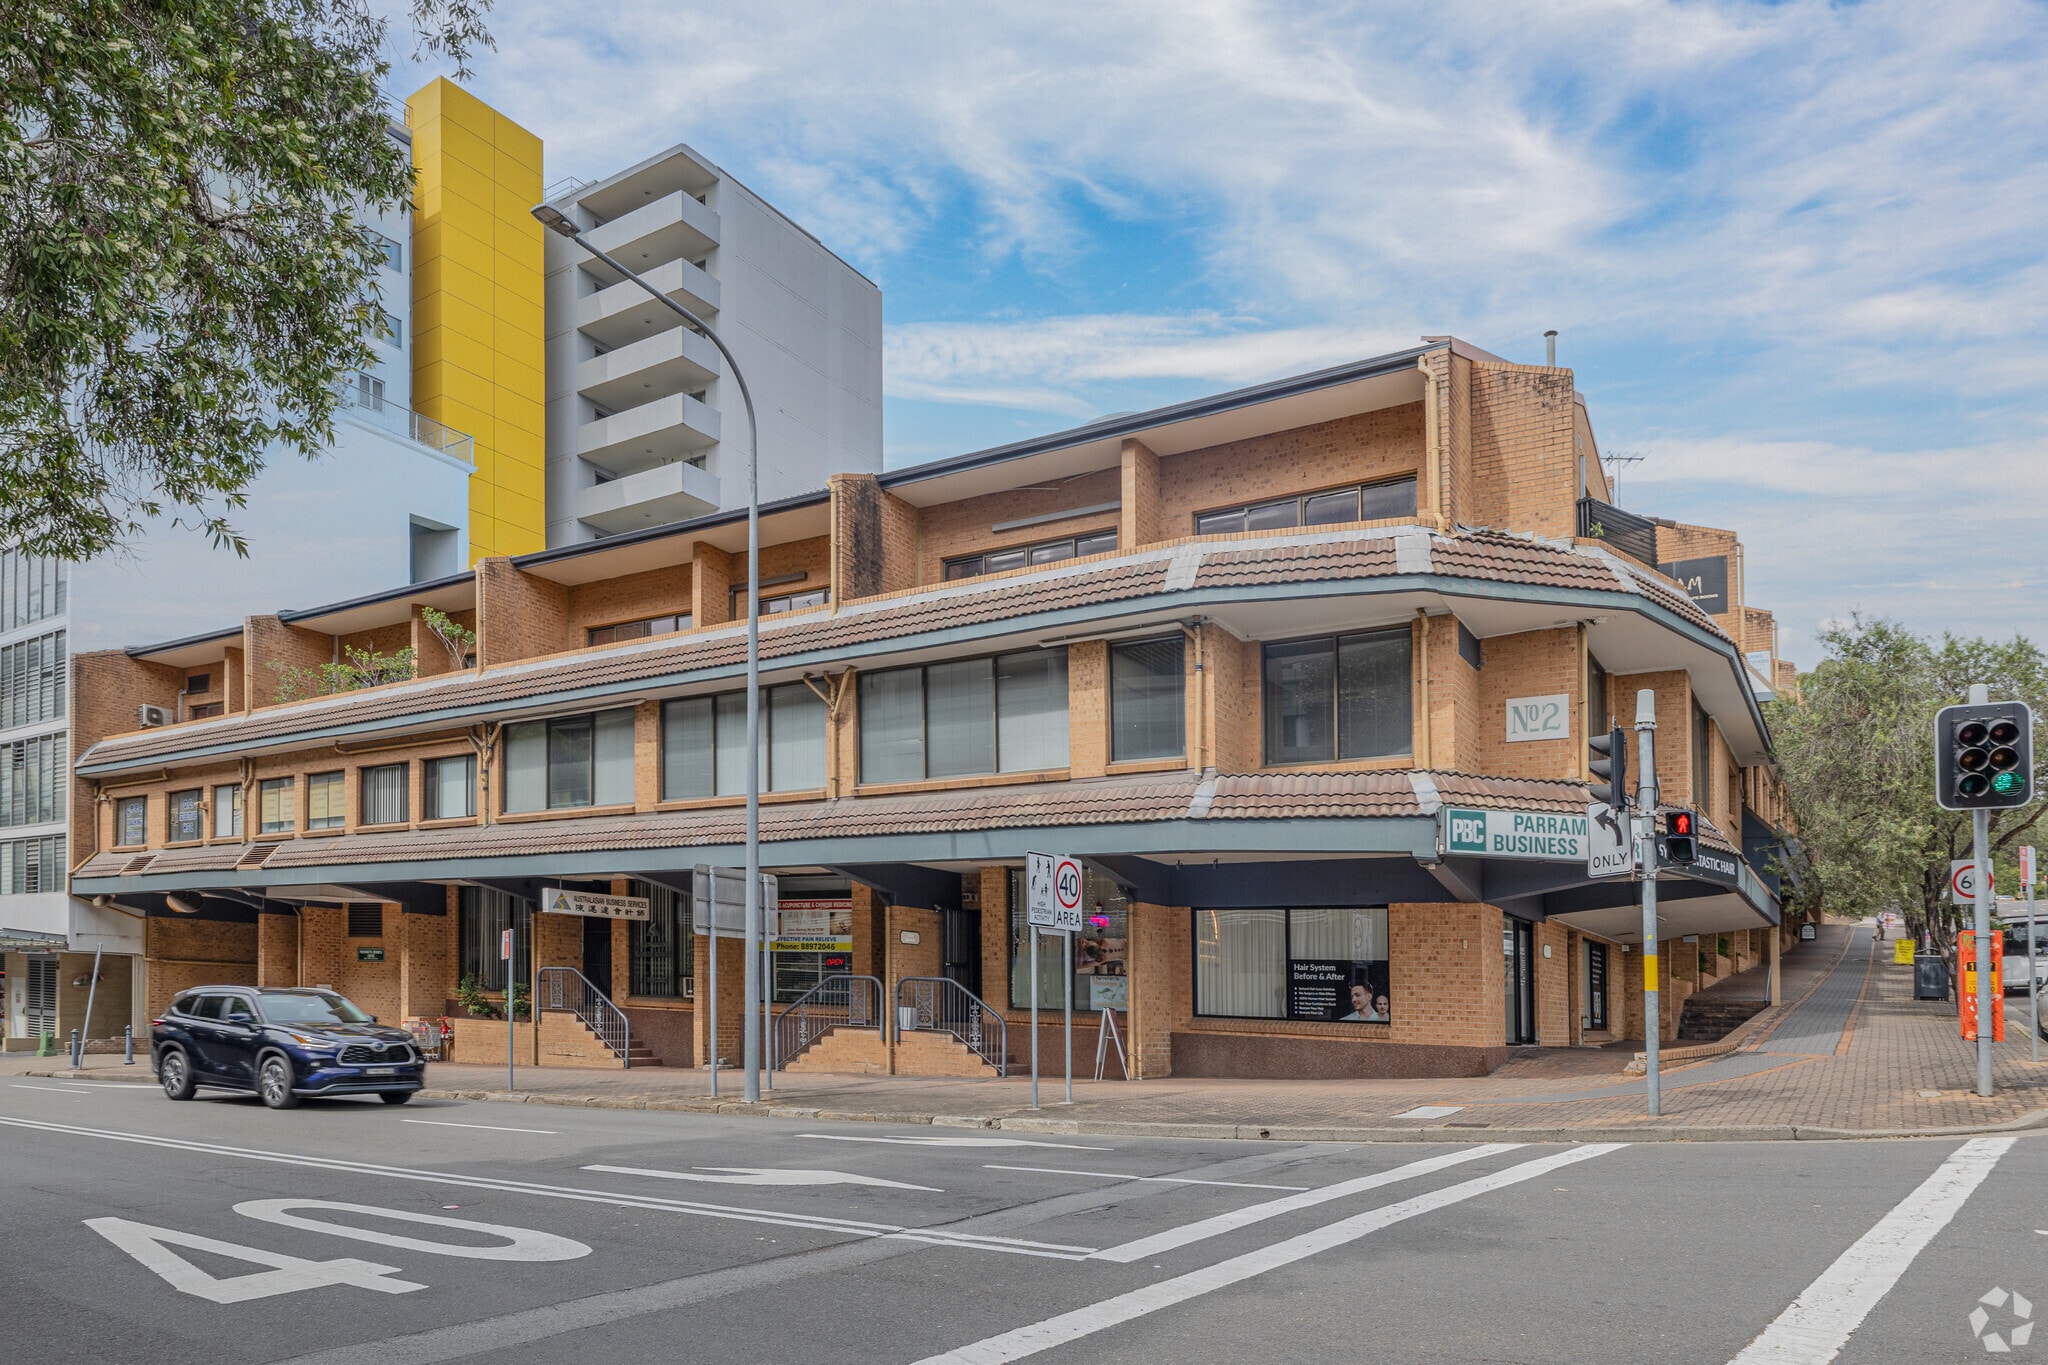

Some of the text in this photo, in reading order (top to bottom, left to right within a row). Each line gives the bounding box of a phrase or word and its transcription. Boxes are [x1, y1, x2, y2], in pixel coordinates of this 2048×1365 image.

[1452, 819, 1484, 844] PBC
[1514, 815, 1587, 836] PARRAM
[1494, 834, 1578, 856] BUSINESS
[1593, 852, 1628, 869] ONLY
[1720, 860, 1736, 876] HAIR
[1059, 873, 1078, 898] 40
[574, 895, 647, 909] AUSTRALASIAN BUSINESS SERVICES
[1031, 907, 1052, 915] PEDESTRIAN
[1056, 911, 1081, 927] AREA
[776, 942, 799, 950] Phone:
[826, 958, 844, 966] OPEN
[1310, 964, 1336, 972] System
[1294, 972, 1318, 980] Before
[1326, 973, 1345, 981] After
[82, 1198, 594, 1304] 40
